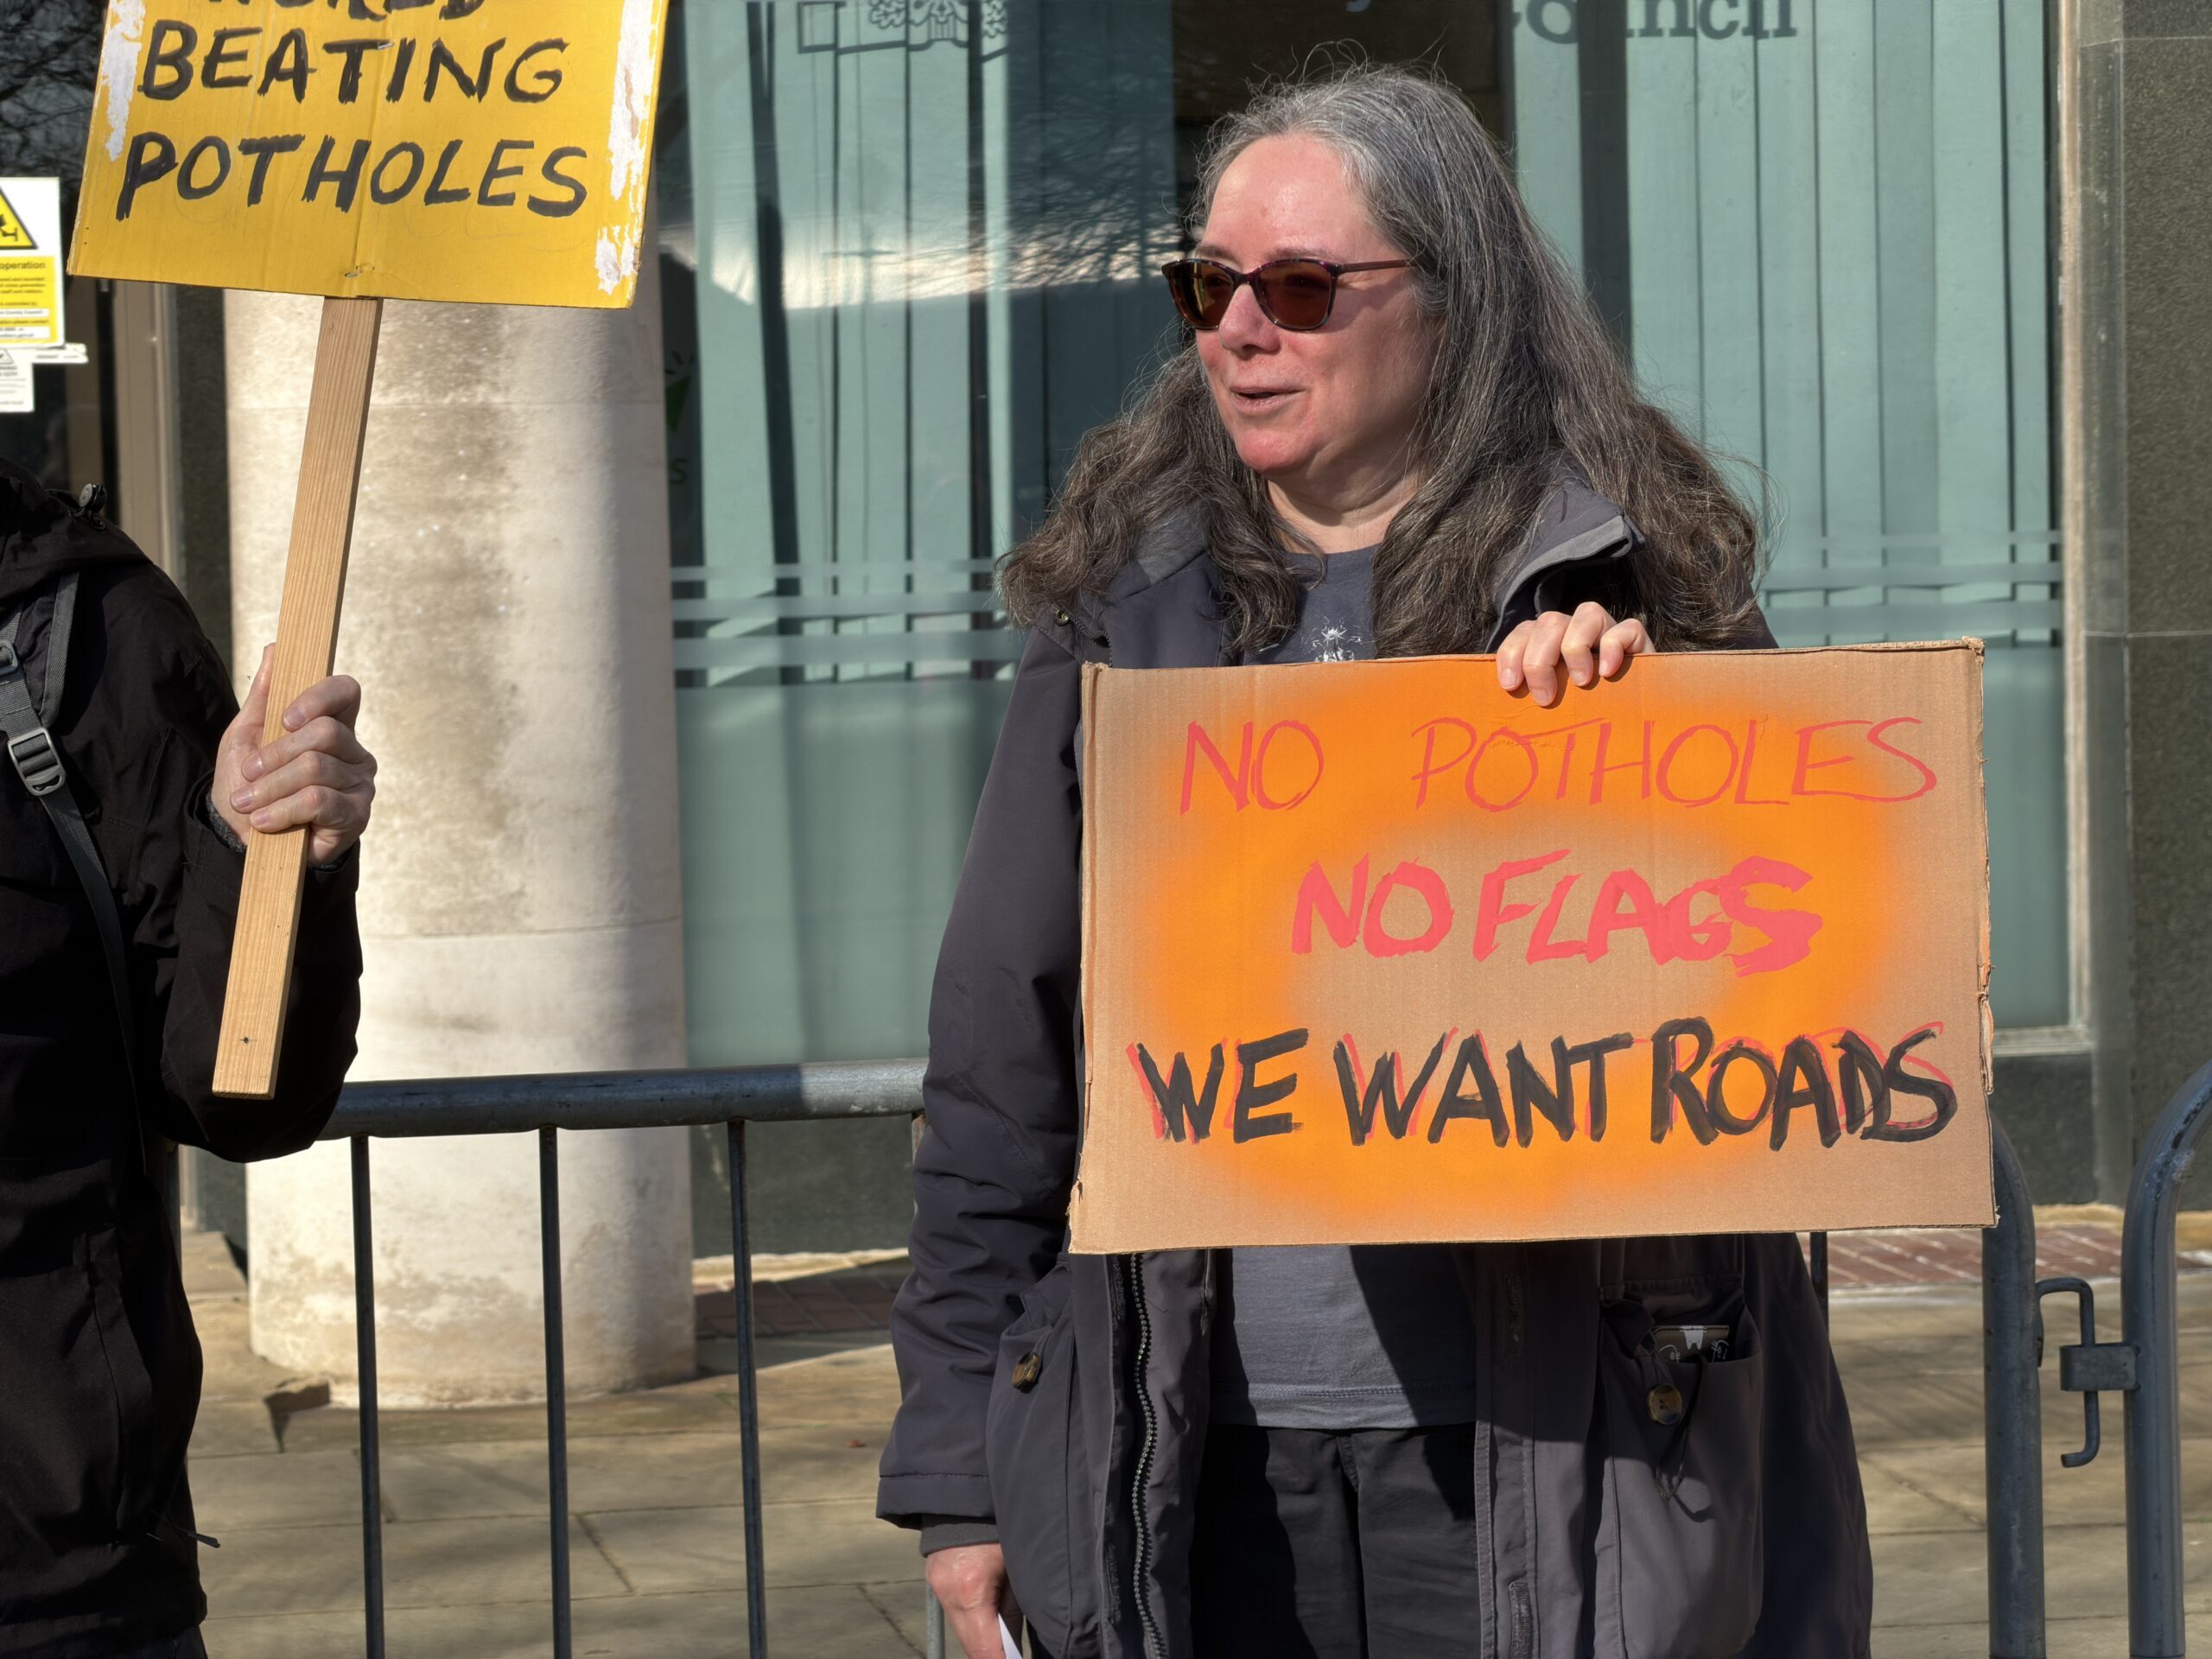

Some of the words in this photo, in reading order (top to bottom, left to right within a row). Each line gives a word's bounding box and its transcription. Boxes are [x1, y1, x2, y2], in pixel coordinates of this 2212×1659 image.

[137, 19, 570, 104] BEATING
[115, 131, 588, 221] POTHOLES
[1179, 719, 1325, 816] NO
[1411, 715, 1936, 813] POTHOLES
[1290, 852, 1454, 957] NO
[1472, 849, 1824, 977] FLAGS
[1125, 1027, 1309, 1145] WE
[1332, 1026, 1636, 1148] WANT
[1649, 1016, 1958, 1152] ROADS
